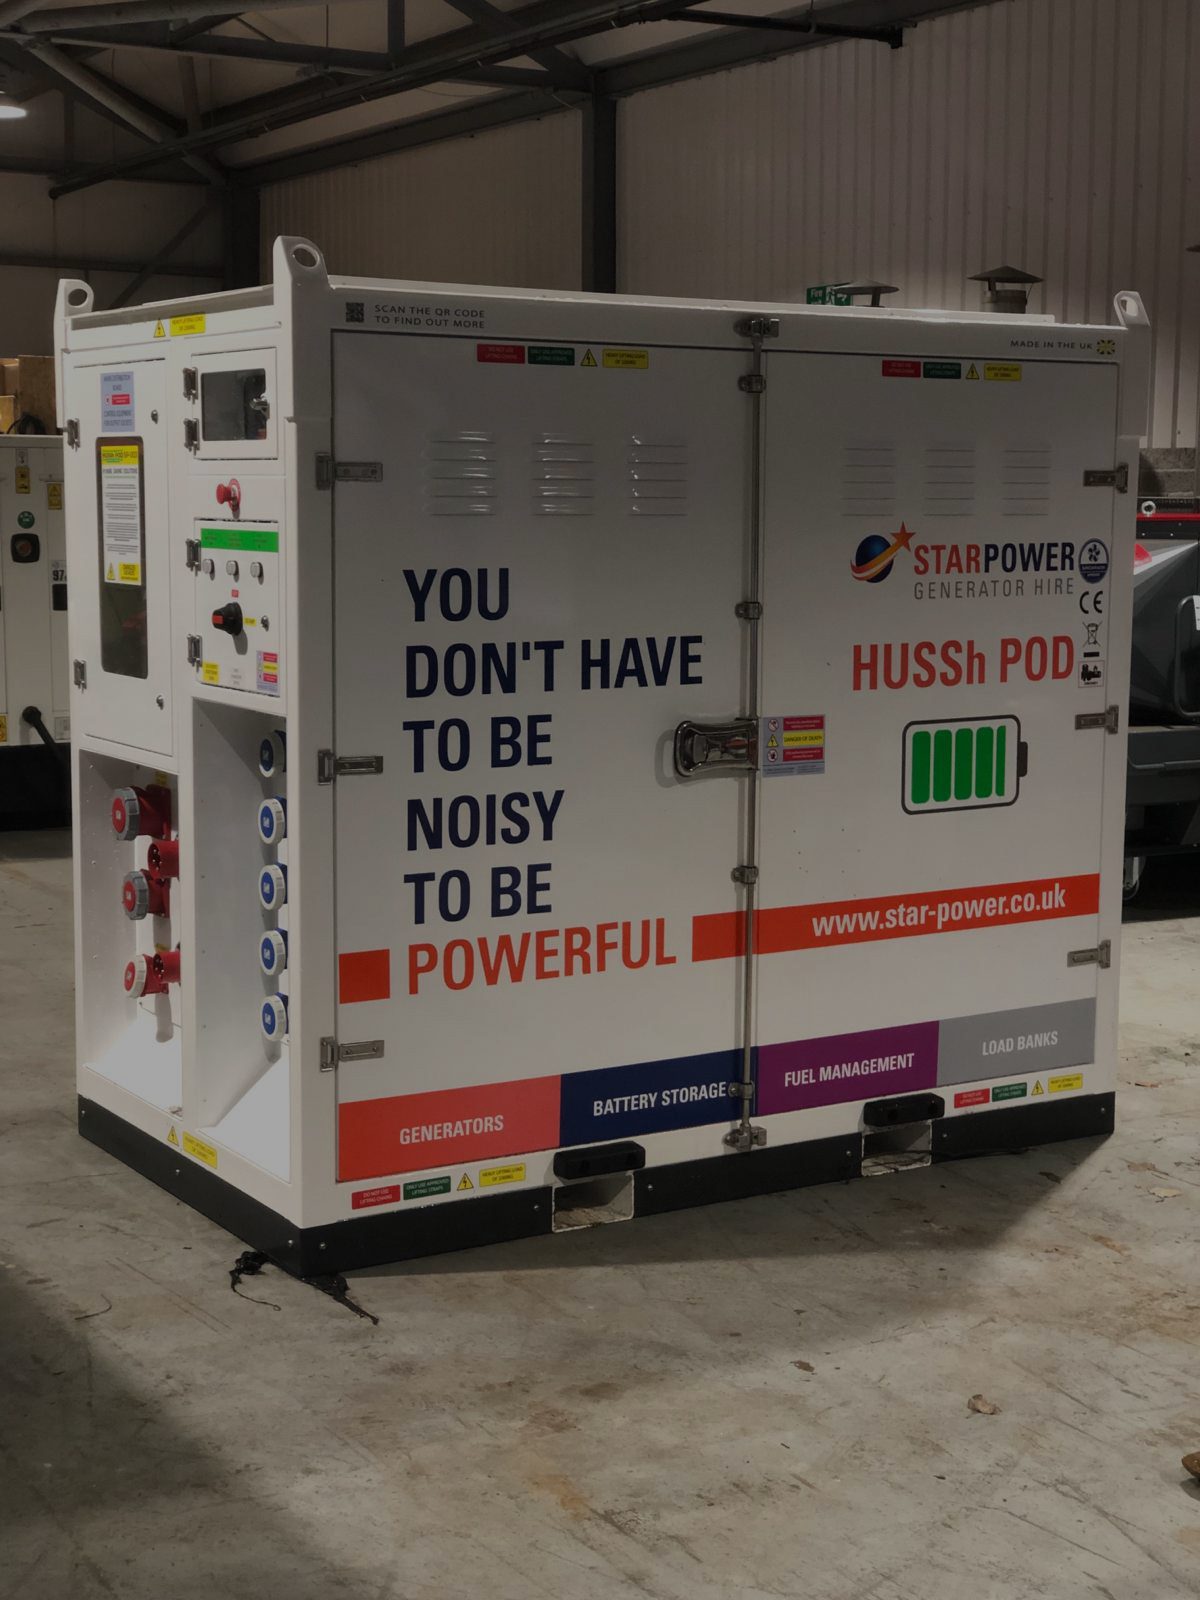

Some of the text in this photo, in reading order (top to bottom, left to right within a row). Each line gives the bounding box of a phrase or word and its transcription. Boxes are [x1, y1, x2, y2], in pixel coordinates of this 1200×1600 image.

[374, 304, 485, 318] SCAN THE QR CODE
[374, 315, 485, 329] TO FIND OUT MORE
[1010, 339, 1093, 350] MADE IN THE UK
[913, 541, 1075, 575] STARPOWER
[402, 567, 510, 622] YOU
[914, 577, 1074, 600] GENERATOR HIRE
[405, 635, 703, 698] DON'T HAVE
[852, 635, 1075, 691] HUSSh POD
[402, 714, 552, 773] TO BE
[406, 789, 565, 851] NOISY
[403, 863, 552, 925] TO BE
[811, 882, 1066, 937] www.star-power.co.uk
[408, 917, 677, 995] POWERFUL
[982, 1030, 1058, 1056] LOAD BANKS
[784, 1052, 915, 1088] FUEL MANAGEMENT
[593, 1081, 727, 1117] BATTERY STORAGE
[399, 1114, 504, 1145] GENERATORS
